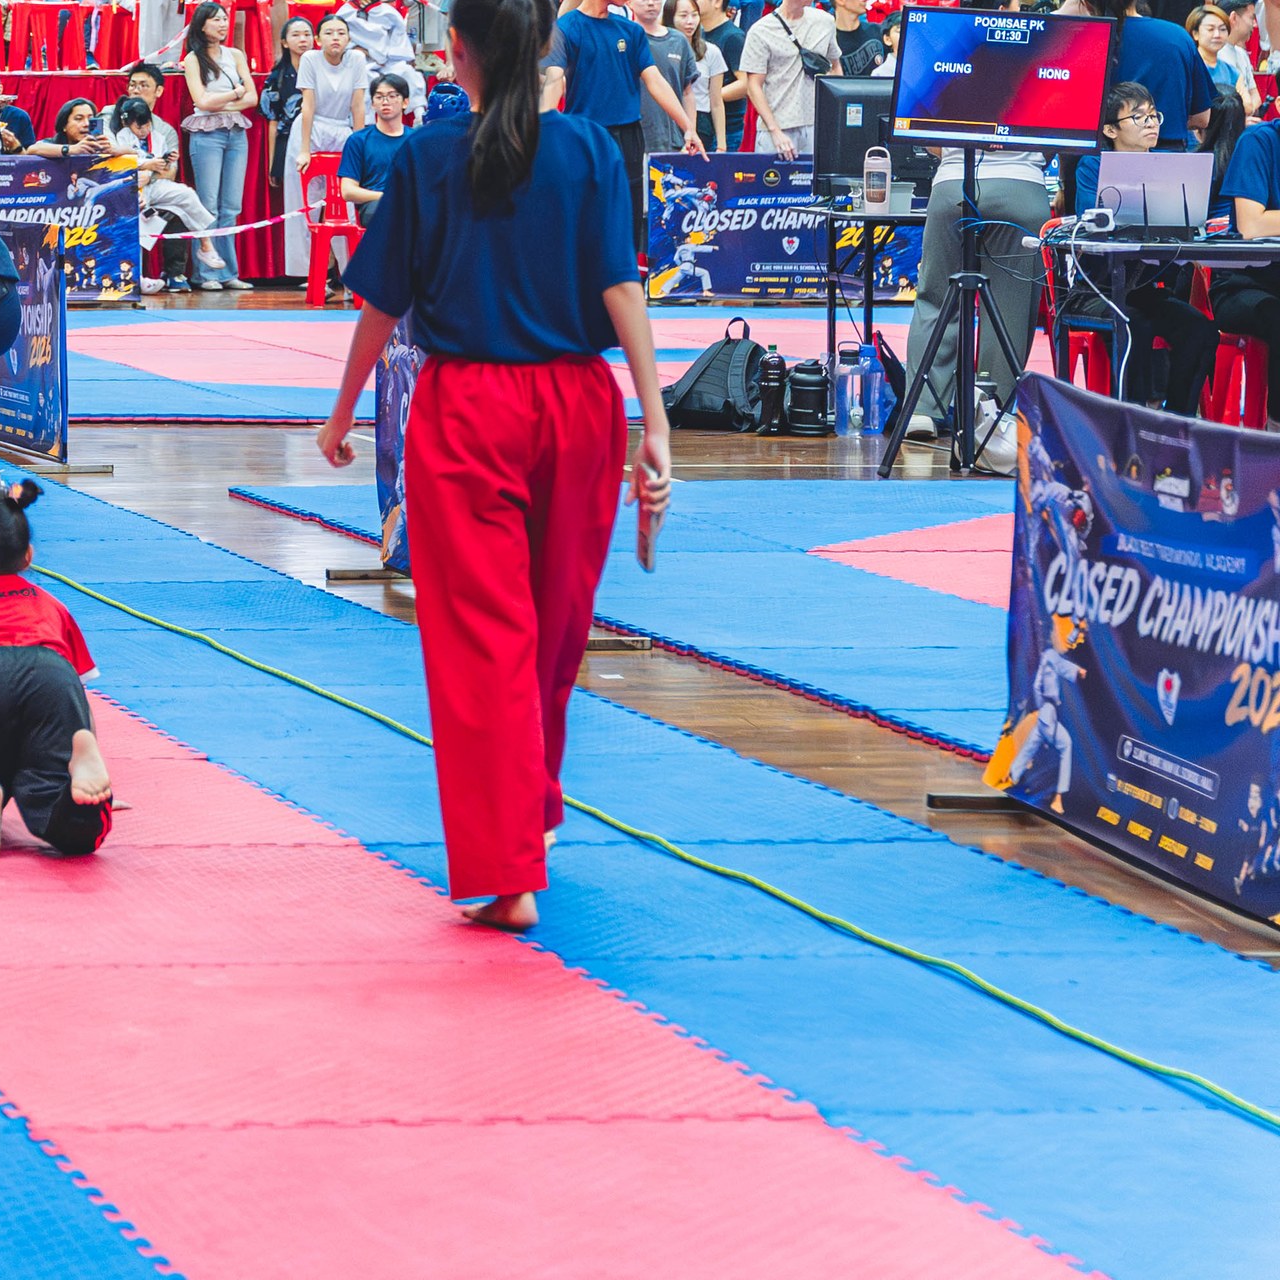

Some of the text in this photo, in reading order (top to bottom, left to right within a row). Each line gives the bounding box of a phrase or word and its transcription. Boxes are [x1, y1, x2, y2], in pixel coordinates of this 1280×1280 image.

[908, 12, 928, 23] B01
[974, 16, 1045, 31] POOMSAE PK
[994, 30, 1022, 41] 01:30
[933, 61, 972, 74] CHUNG
[1038, 68, 1070, 80] HONG
[895, 119, 908, 129] R1
[997, 125, 1009, 135] R2
[16, 195, 47, 204] ACADEMY
[737, 197, 758, 206] BLACK
[760, 196, 775, 205] BELT
[777, 195, 815, 205] TAEKWONDO
[681, 209, 755, 233] CLOSED
[1043, 551, 1280, 666] CLOSED CHAMPIONSH
[1224, 662, 1280, 735] 202
